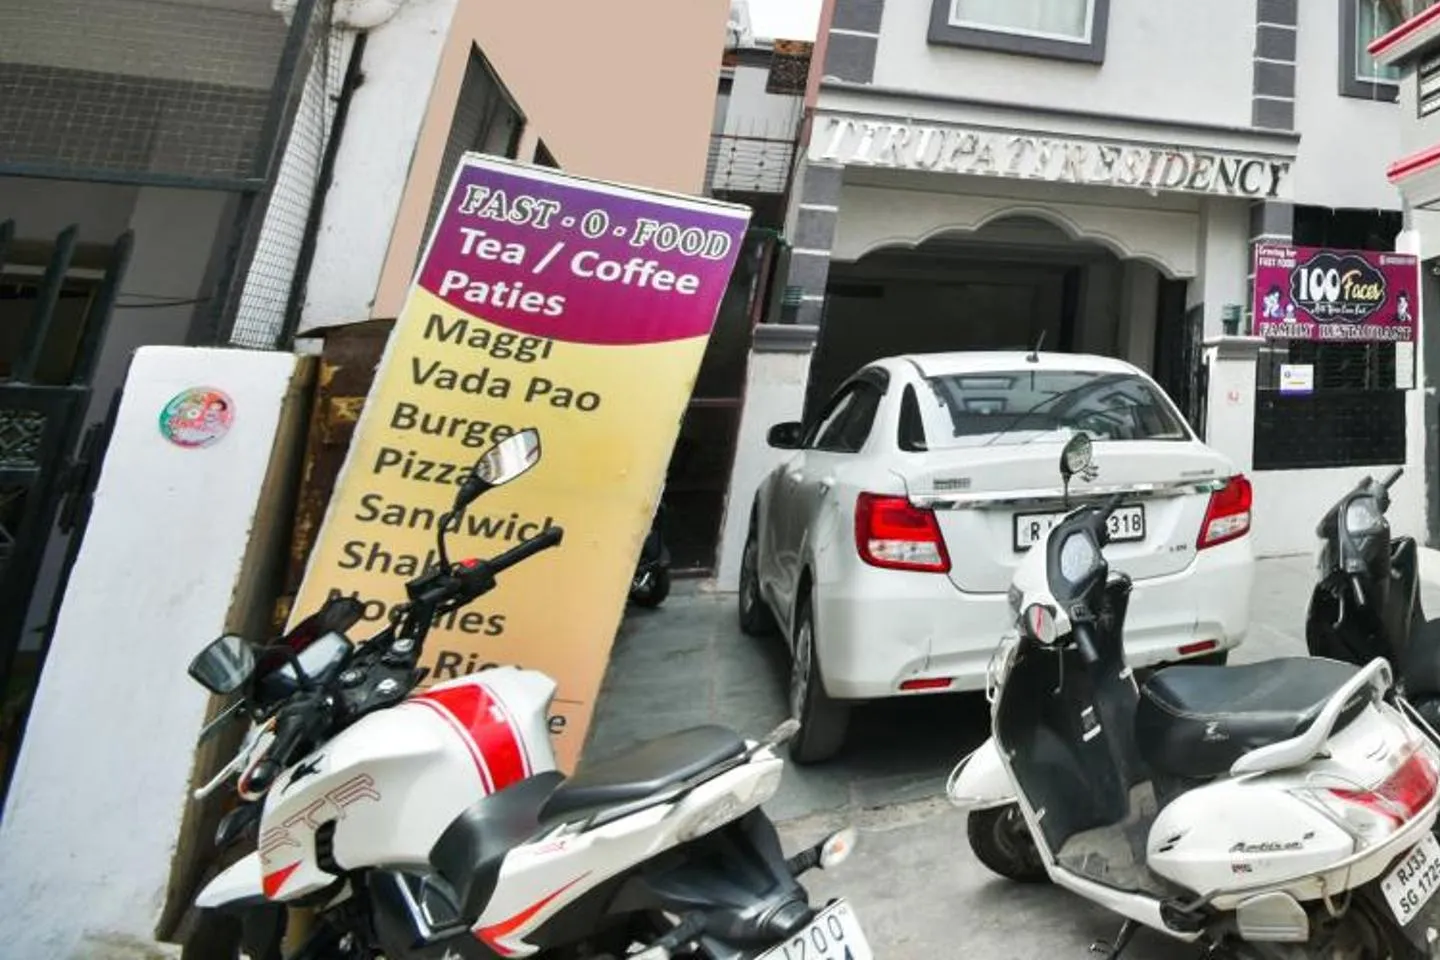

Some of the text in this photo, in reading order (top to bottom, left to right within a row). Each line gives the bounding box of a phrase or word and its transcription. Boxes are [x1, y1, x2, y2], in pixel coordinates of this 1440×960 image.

[1060, 141, 1291, 198] RESIDENCY
[458, 184, 561, 229] FAST
[629, 217, 732, 260] FOOD
[459, 226, 700, 296] Tea / Coffee
[1299, 267, 1342, 303] 100
[438, 270, 566, 317] Paties
[423, 313, 553, 364] Maggi
[1259, 322, 1413, 341] FAMILY RESTAURANT
[411, 357, 601, 413] Vada Pao
[390, 401, 528, 449] Burge
[1397, 847, 1427, 887] RJ33
[1400, 888, 1419, 915] SG
